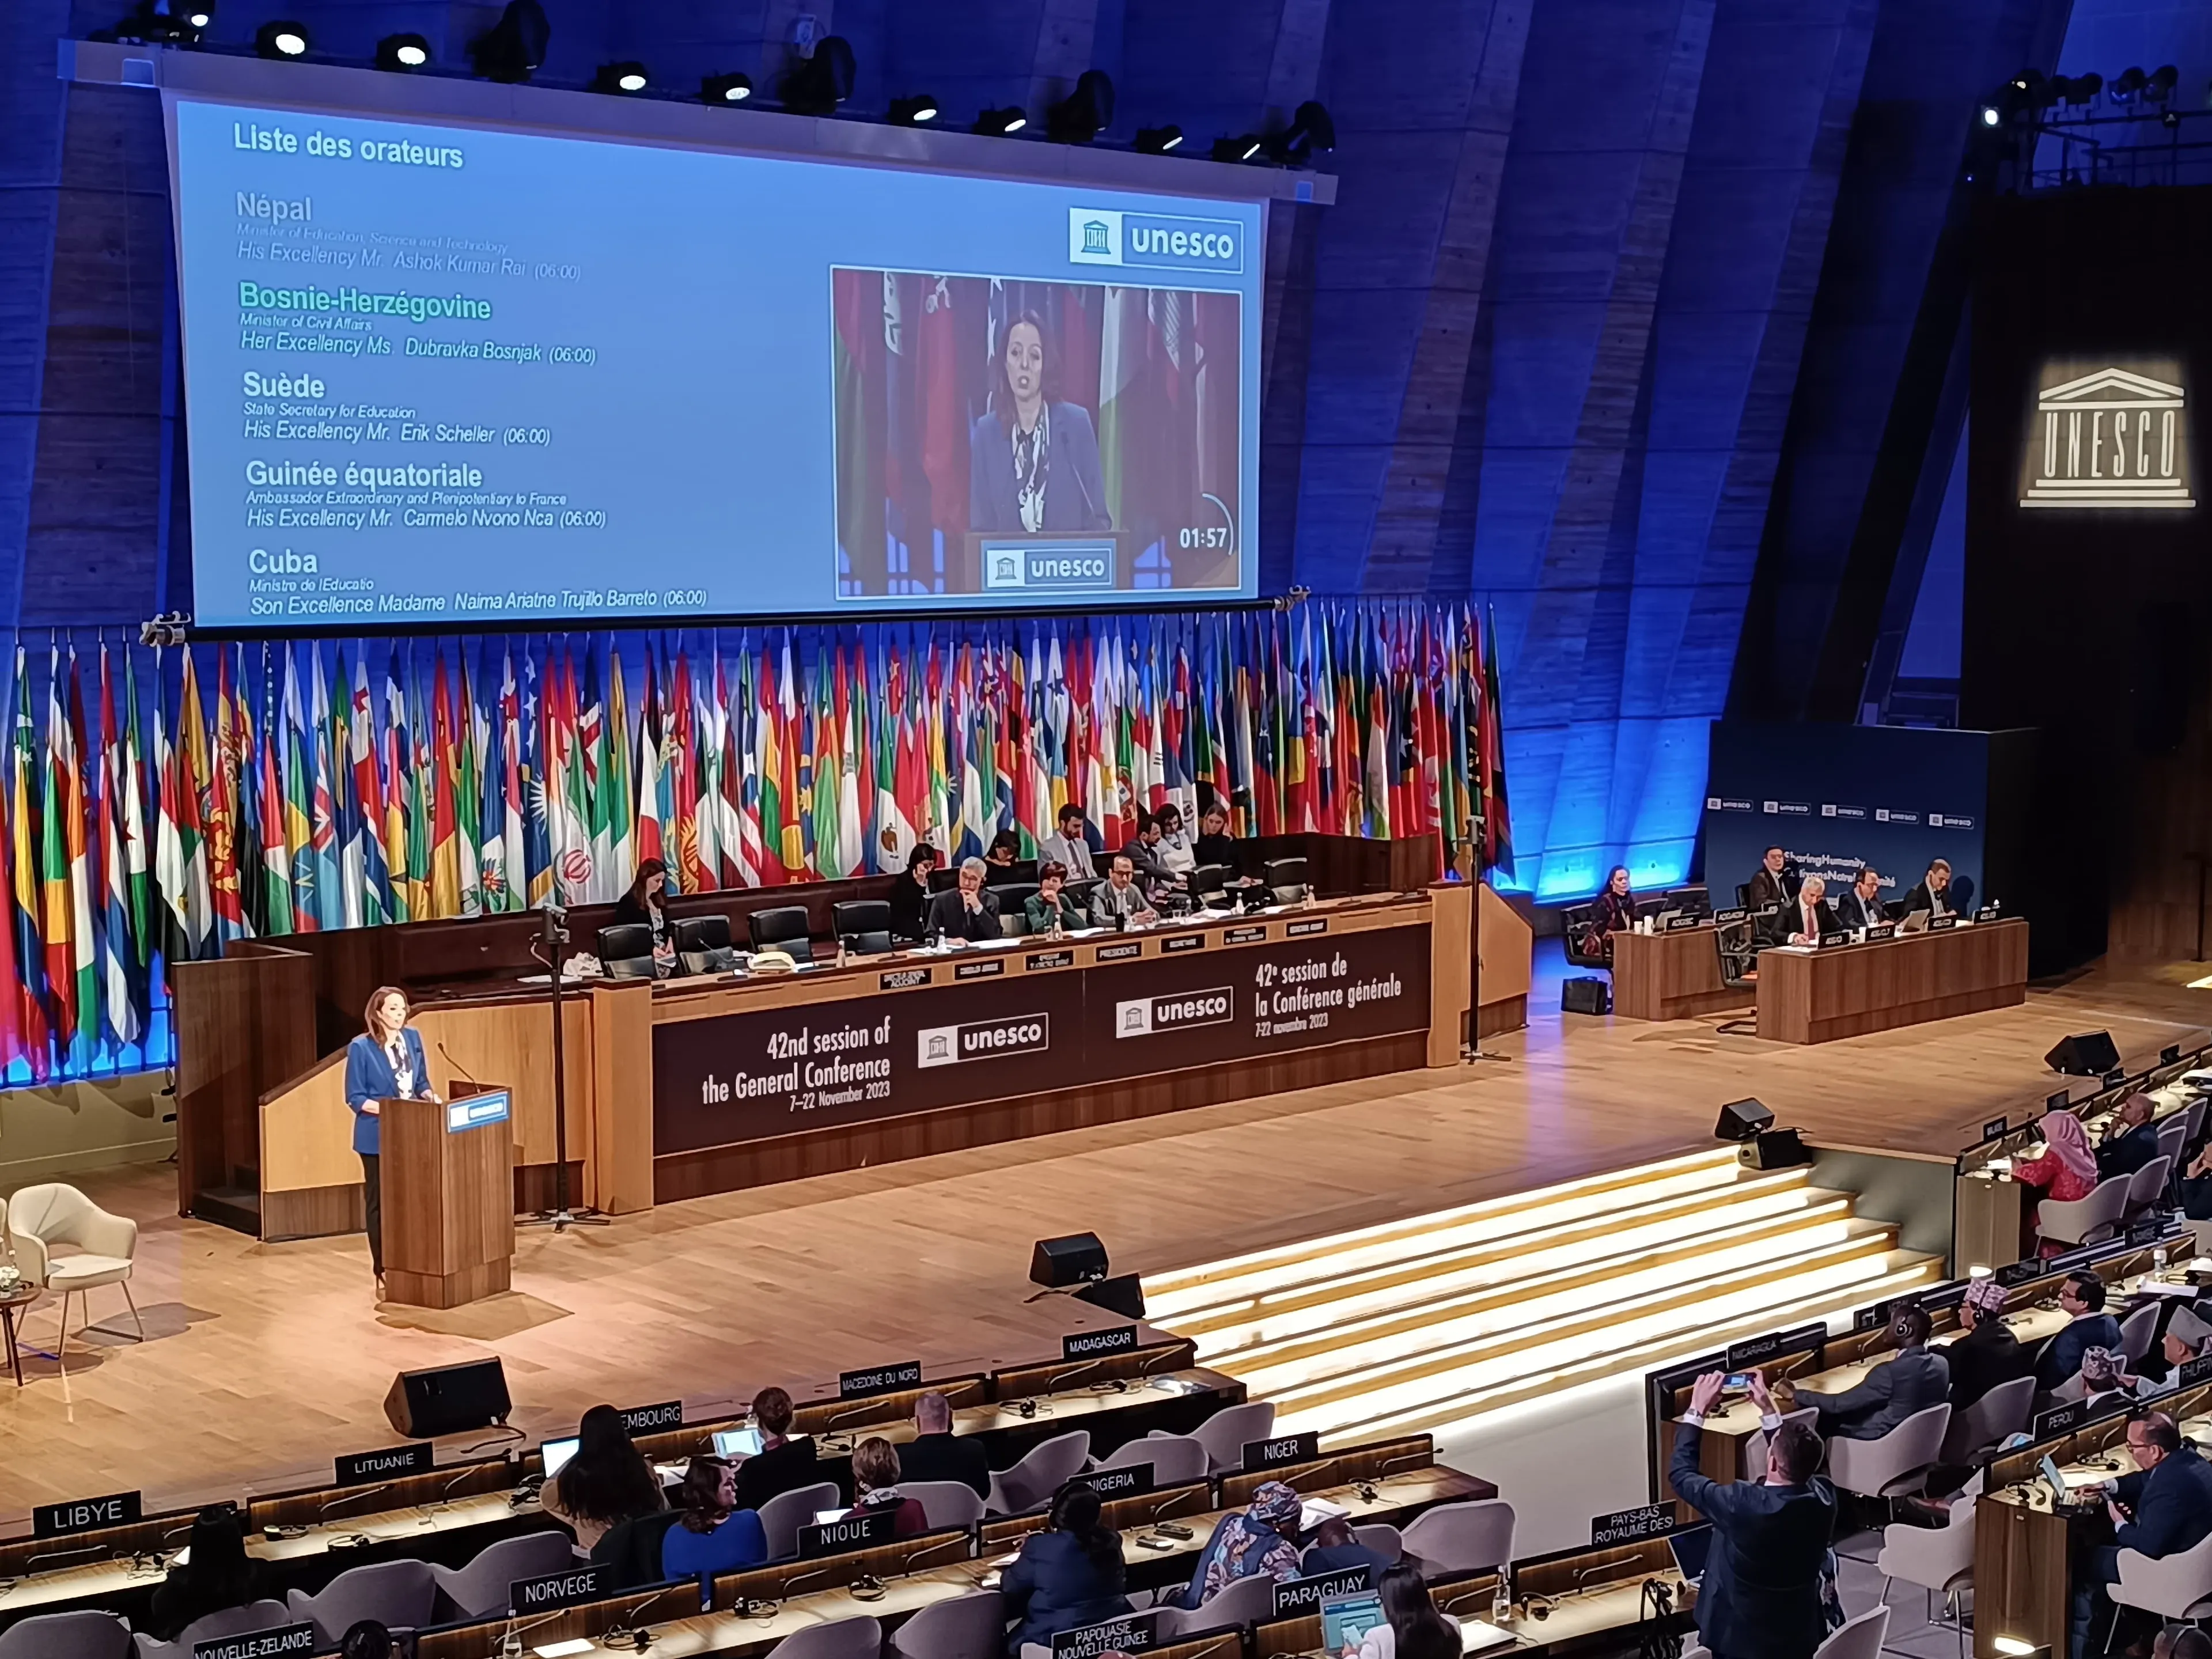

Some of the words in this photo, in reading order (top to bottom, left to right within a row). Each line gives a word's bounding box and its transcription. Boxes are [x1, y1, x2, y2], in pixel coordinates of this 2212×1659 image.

[234, 122, 297, 153] Liste
[306, 130, 352, 158] des
[360, 138, 463, 168] orateurs
[236, 191, 312, 225] Népal
[237, 222, 284, 237] Minister
[289, 227, 301, 238] of
[419, 237, 441, 248] and
[446, 237, 507, 255] Technology
[1131, 226, 1234, 259] unesco
[237, 240, 264, 260] His
[270, 243, 356, 269] Excellency
[361, 249, 385, 267] Mr.
[393, 251, 442, 271] Ashok
[447, 255, 497, 274] Kumar
[535, 263, 581, 282] (06:00)
[239, 281, 491, 324] Bosnie-Herzégovine
[240, 313, 287, 327] Minister
[292, 316, 304, 328] of
[306, 316, 331, 329] Civil
[334, 317, 373, 331] Affairs
[241, 330, 272, 349] Her
[276, 332, 362, 357] Excellency
[367, 336, 395, 355] Ms.
[406, 338, 478, 359] Dubravka
[483, 340, 541, 363] Bosnjak
[549, 347, 596, 366] (06:00)
[243, 370, 325, 399] Suède
[243, 402, 275, 415] State
[279, 403, 336, 419] Secretary
[339, 404, 355, 418] for
[358, 405, 416, 419] Education
[244, 419, 271, 438] His
[276, 420, 363, 444] Excellency
[366, 422, 391, 441] Mr.
[401, 423, 430, 442] Erik
[435, 424, 495, 444] Scheller
[503, 427, 551, 446] (06:00)
[2044, 410, 2175, 478] UNESCO
[245, 460, 338, 487] Guinée
[345, 461, 483, 494] équatoriale
[246, 491, 323, 504] Ambassador
[326, 491, 404, 507] Extraordinary
[407, 492, 429, 505] and
[516, 493, 527, 505] to
[529, 493, 567, 505] France
[247, 509, 274, 527] His
[279, 509, 366, 530] Excellency
[370, 508, 393, 527] Mr.
[404, 509, 468, 526] Carmelo
[472, 509, 520, 526] Nvono
[524, 509, 554, 526] Nca
[559, 511, 606, 529] (06:00)
[1179, 527, 1228, 550] 01:57
[249, 548, 319, 574] Cuba
[1031, 556, 1105, 578] unesco
[251, 597, 283, 615] Son
[287, 596, 374, 615] Excellence
[378, 593, 446, 612] Madame
[454, 592, 502, 610] Naima
[561, 590, 603, 611] Trujillo
[607, 589, 657, 607] Barreto
[663, 590, 707, 608] (06:00)
[1282, 957, 1327, 984] session
[1331, 952, 1347, 978] de
[1256, 994, 1268, 1018] la
[1273, 982, 1343, 1016] Conférence
[1347, 973, 1402, 1009] générale
[1157, 996, 1227, 1022] unesco
[1309, 1013, 1328, 1029] 2023
[767, 1027, 808, 1060] 42nd
[813, 1022, 869, 1054] session
[874, 1015, 891, 1044] of
[964, 1023, 1042, 1052] unesco
[702, 1074, 729, 1105] the
[736, 1062, 798, 1099] General
[805, 1055, 891, 1088] Conference
[819, 1086, 863, 1107] November
[866, 1081, 891, 1099] 2023
[1069, 1331, 1132, 1353] MADAGASCAR
[885, 1372, 896, 1384] DU
[620, 1406, 680, 1430] EMBOURG
[354, 1452, 415, 1474] LITUANIE
[1264, 1440, 1298, 1460] NIGER
[1087, 1473, 1135, 1491] NIGERIA
[54, 1499, 123, 1529] LIBYE
[1611, 1506, 1660, 1527] PAYS-BAS
[820, 1520, 872, 1545] NIOUE
[525, 1573, 597, 1604] NORVEGE
[1279, 1574, 1365, 1608] PARAGUAY
[1058, 1638, 1112, 1659] NOUVELLE
[1112, 1630, 1149, 1650] GUINEE
[1075, 1620, 1132, 1645] PAPOUASIE
